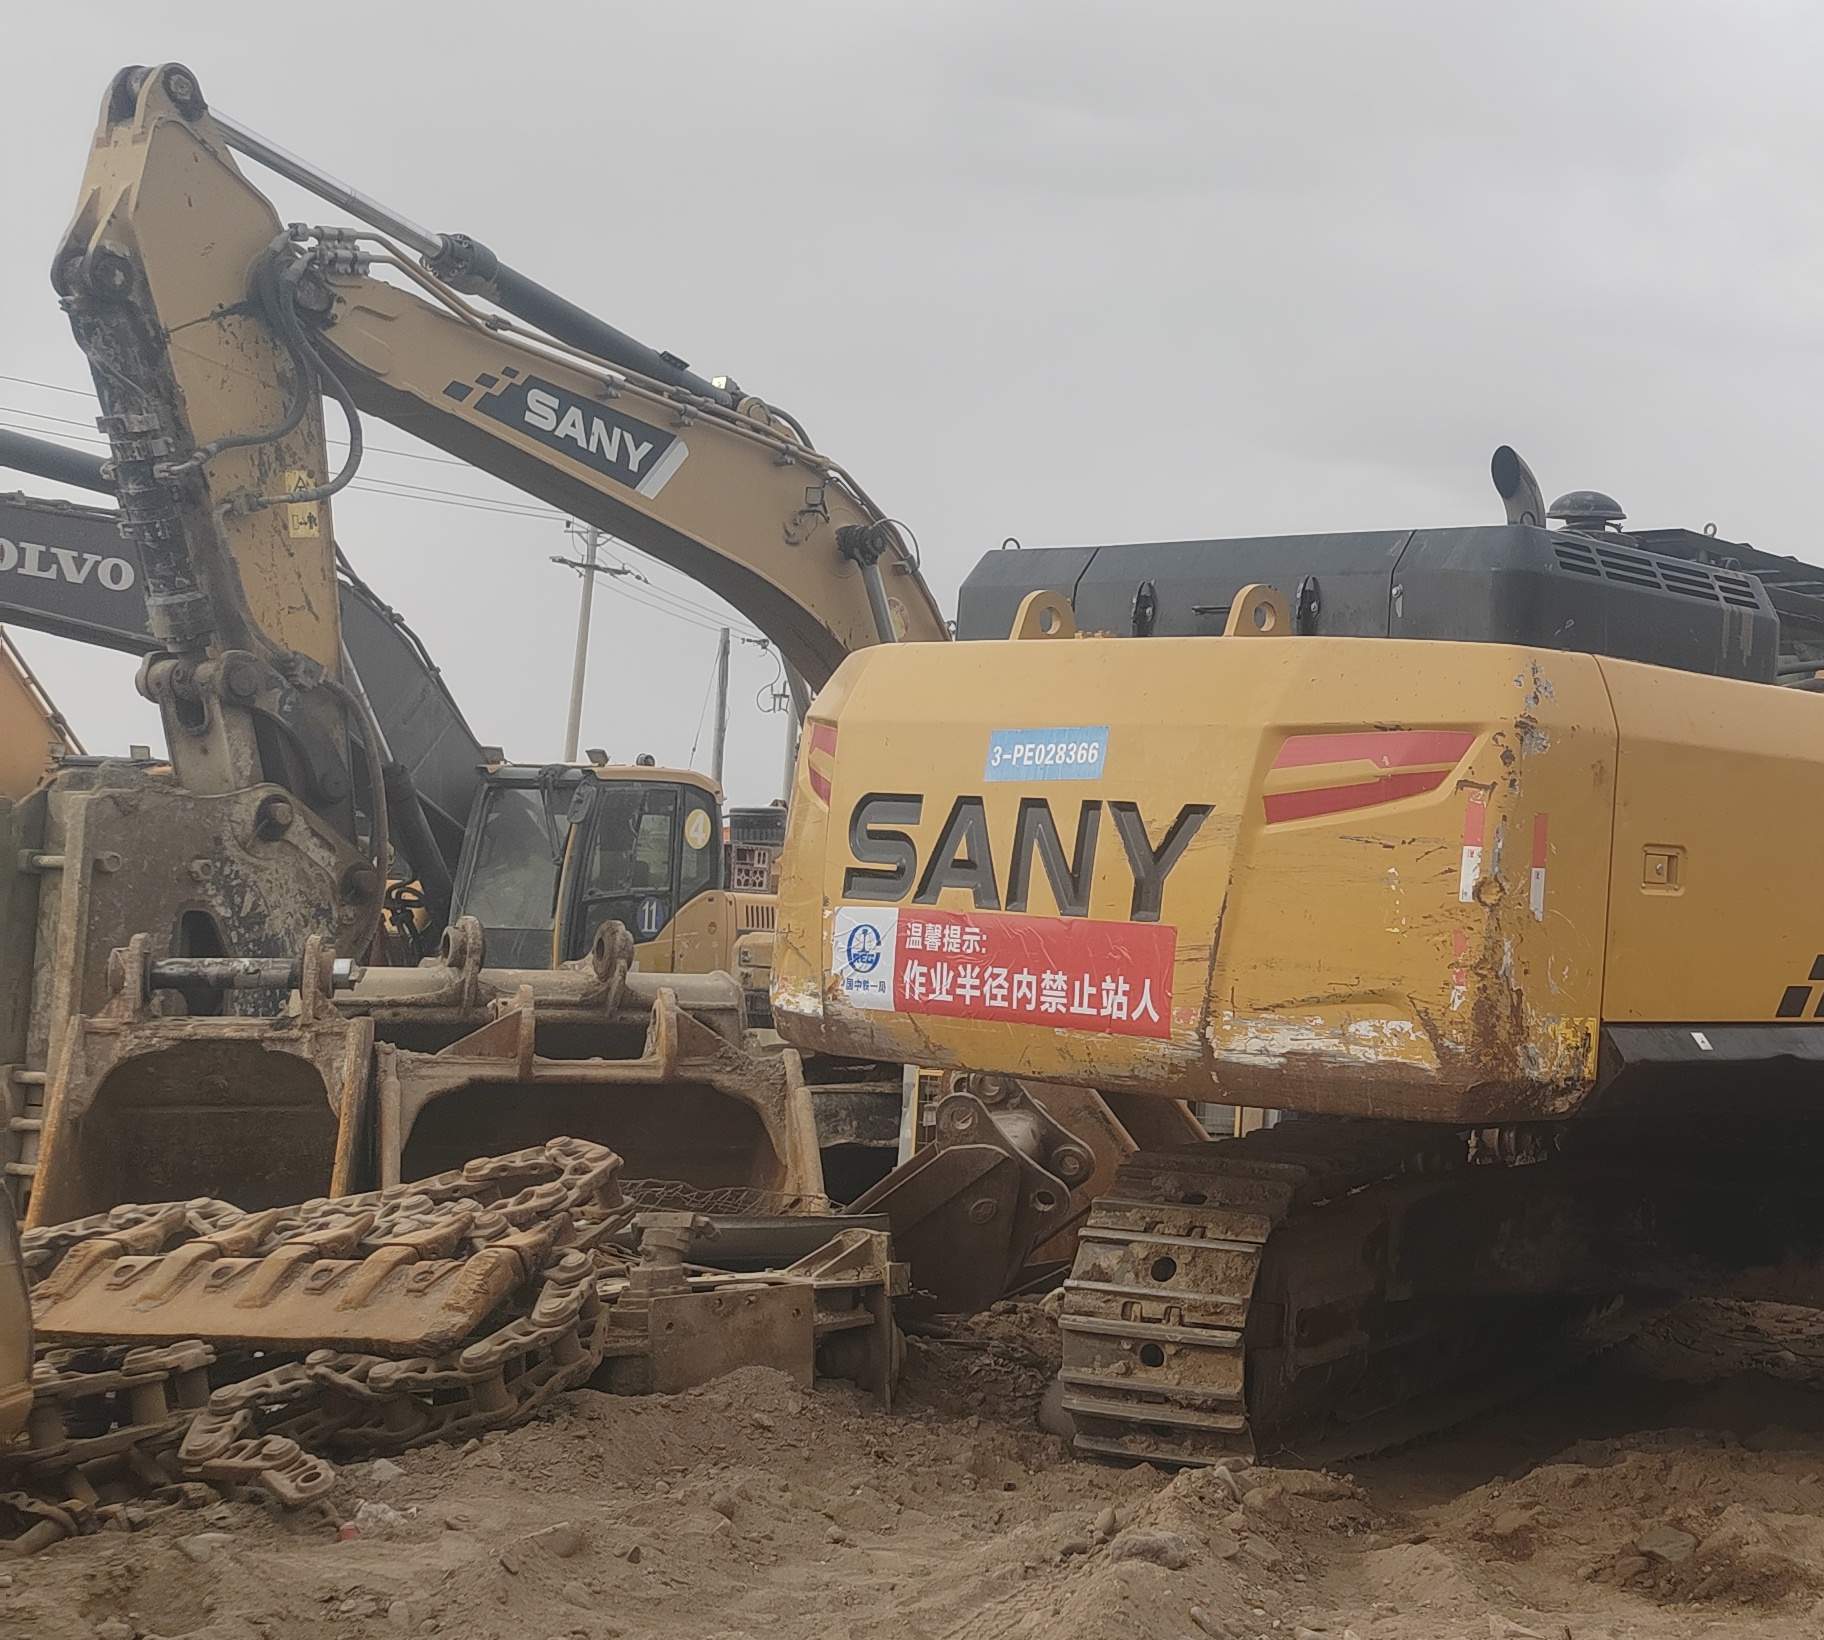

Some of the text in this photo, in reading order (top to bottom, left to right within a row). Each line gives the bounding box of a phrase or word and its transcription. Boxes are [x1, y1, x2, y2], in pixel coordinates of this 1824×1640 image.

[524, 388, 654, 473] SANY
[991, 742, 1099, 766] 3-PE028366
[689, 815, 706, 843] 4
[842, 792, 1216, 922] SANY
[641, 901, 658, 932] 11
[905, 922, 987, 954] 温馨提示:
[903, 959, 1160, 1023] 作业半径内禁止站人
